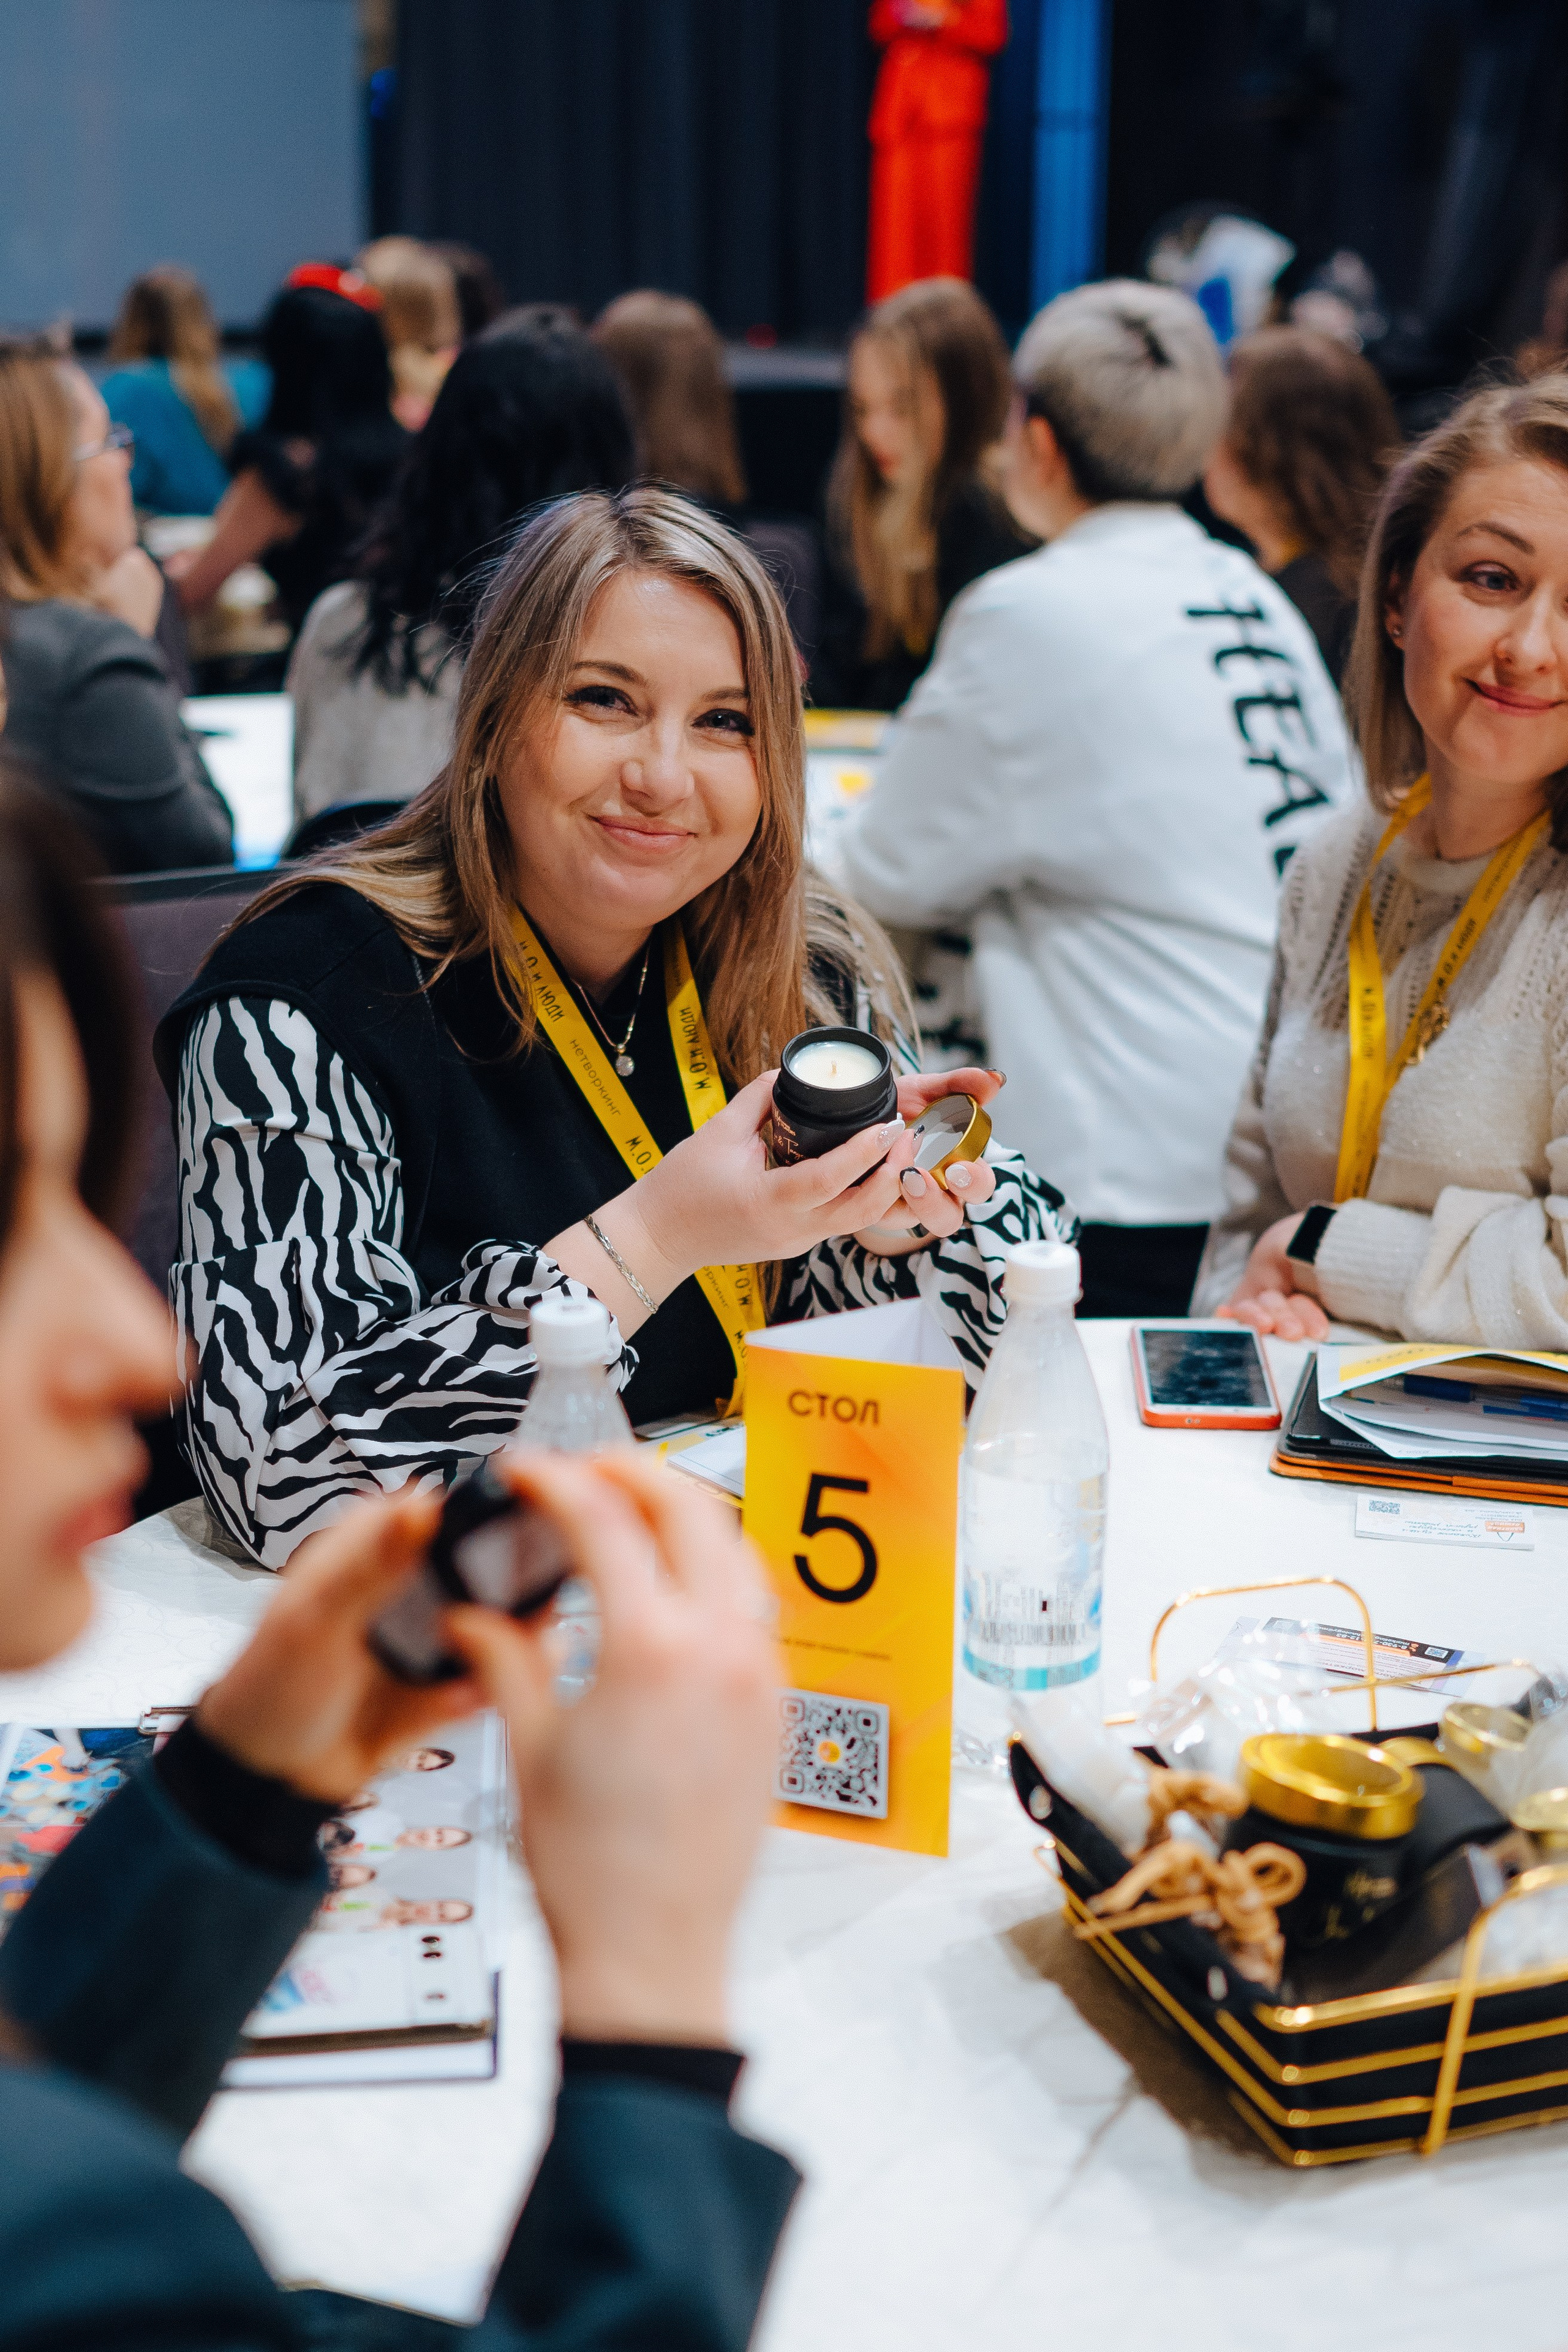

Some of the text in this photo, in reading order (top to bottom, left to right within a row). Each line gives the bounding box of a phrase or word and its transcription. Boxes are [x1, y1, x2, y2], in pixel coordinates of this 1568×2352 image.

[570, 1039, 621, 1117] нетворкинг
[788, 1389, 880, 1426] СТОЛ
[793, 1472, 878, 1604] 5
